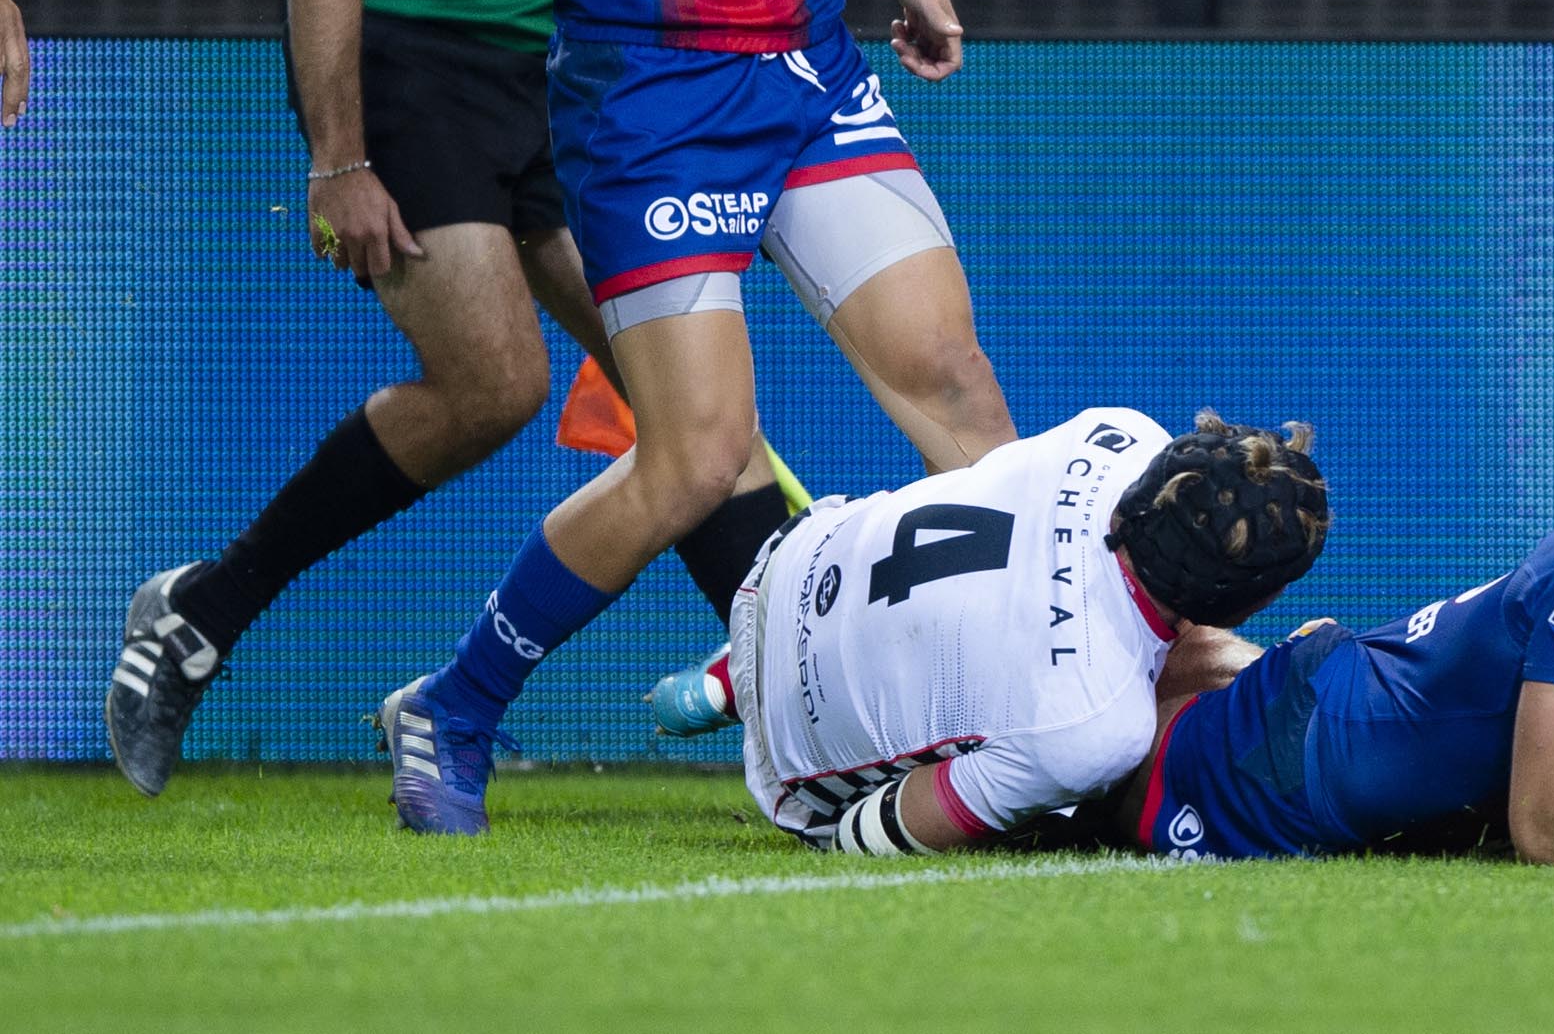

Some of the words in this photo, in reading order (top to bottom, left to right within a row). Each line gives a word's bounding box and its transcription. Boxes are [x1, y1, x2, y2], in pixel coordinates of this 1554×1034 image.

[687, 192, 769, 235] STEAP
[868, 504, 1015, 606] 4
[1050, 458, 1092, 666] CHEVAL
[485, 589, 545, 659] FCG
